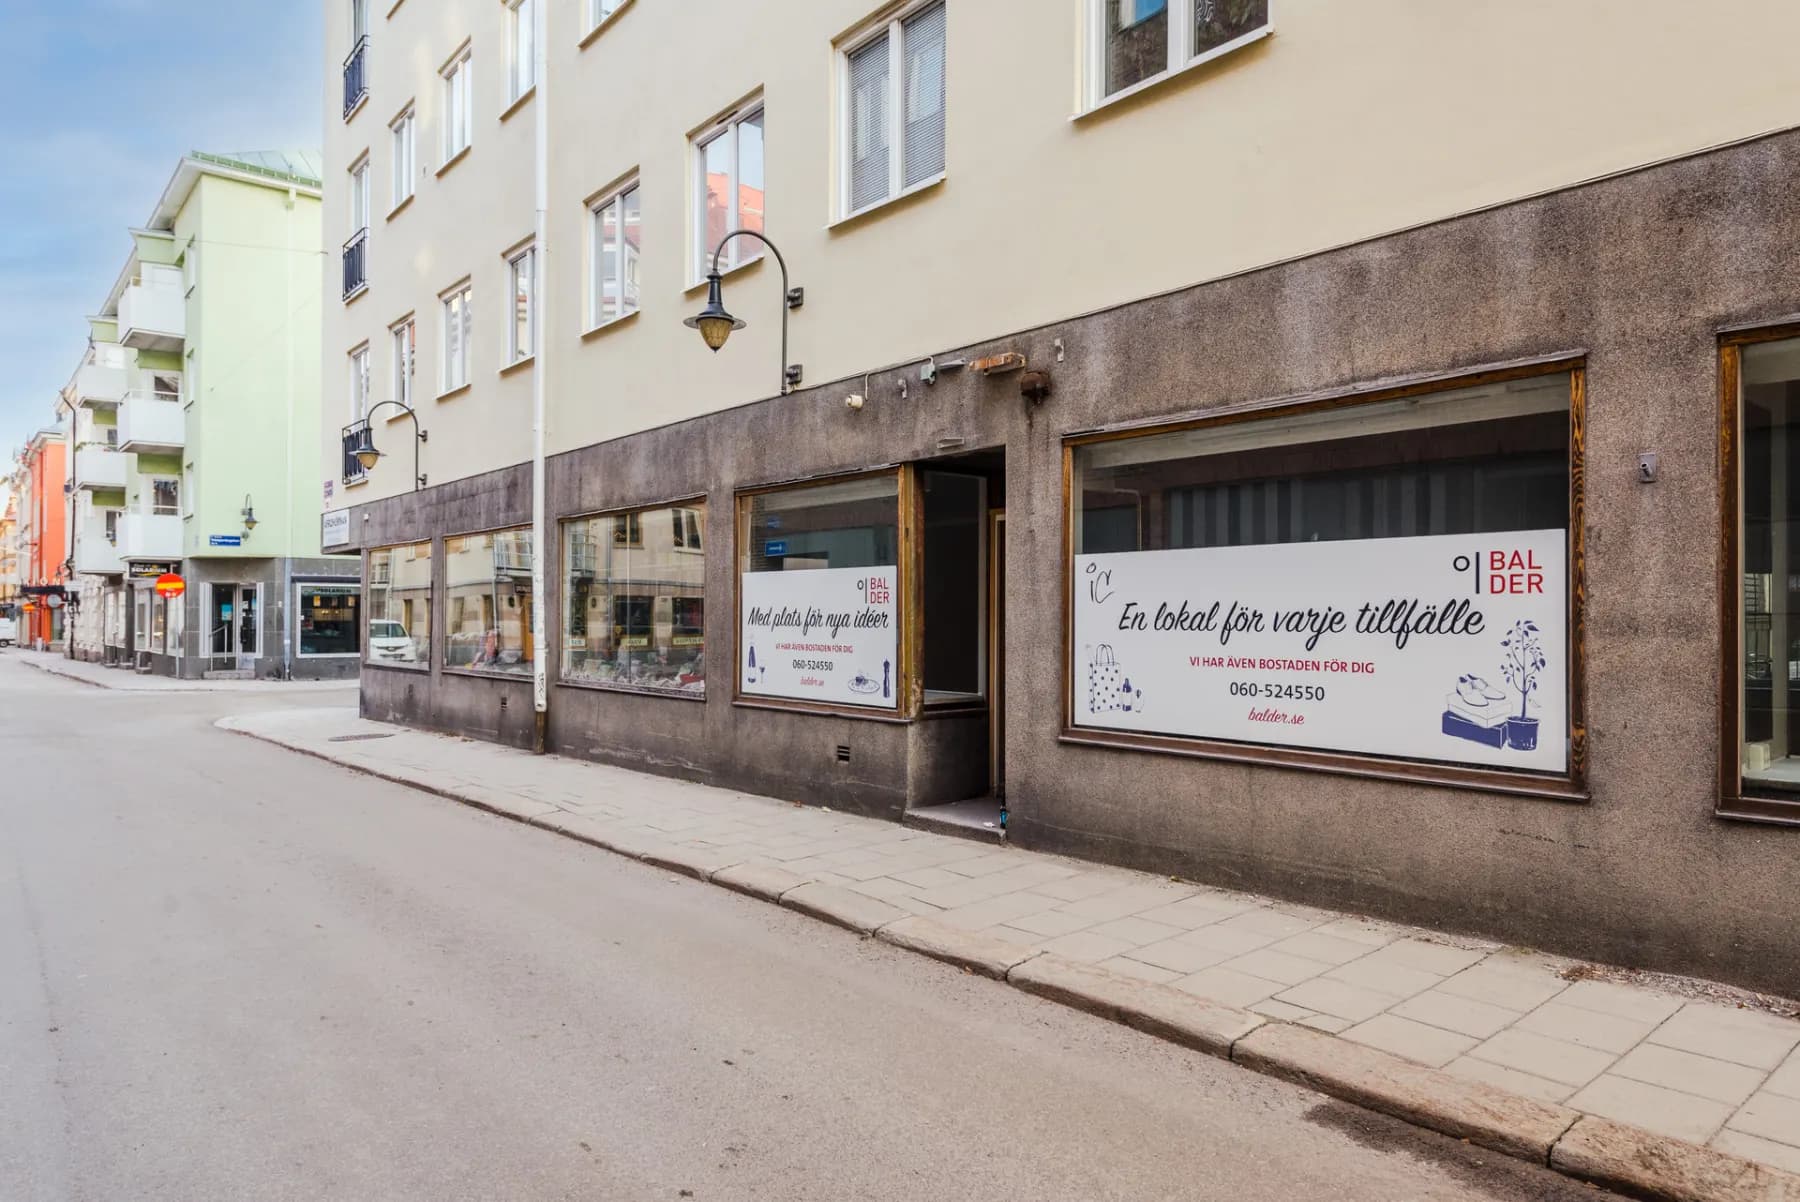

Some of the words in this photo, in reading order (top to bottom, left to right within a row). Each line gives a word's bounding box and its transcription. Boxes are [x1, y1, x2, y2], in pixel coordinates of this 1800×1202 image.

[1489, 549, 1542, 571] BAL
[870, 576, 889, 590] BAL
[1489, 573, 1544, 595] DER
[870, 591, 890, 604] DER
[748, 606, 772, 626] Med
[770, 605, 802, 633] plats
[803, 605, 823, 636] för
[826, 612, 851, 640] nya
[853, 605, 889, 629] idéer
[1118, 602, 1148, 631] En
[1153, 599, 1218, 631] lokal
[1220, 600, 1265, 646] för
[1273, 605, 1347, 652] varje
[1355, 598, 1485, 650] tillfälle
[805, 643, 832, 653] BOSTADEN
[832, 644, 842, 653] FÖR
[843, 645, 853, 653] DIG
[792, 659, 834, 672] 060-524550
[1189, 656, 1201, 667] VI
[1202, 656, 1224, 668] HAR
[1226, 655, 1256, 669] ÄVEN
[1259, 658, 1320, 672] BOSTADEN
[1323, 658, 1348, 673] FÖR
[1351, 661, 1375, 674] DIG
[1229, 681, 1326, 701] 060-524550
[1247, 707, 1305, 726] balder.se
